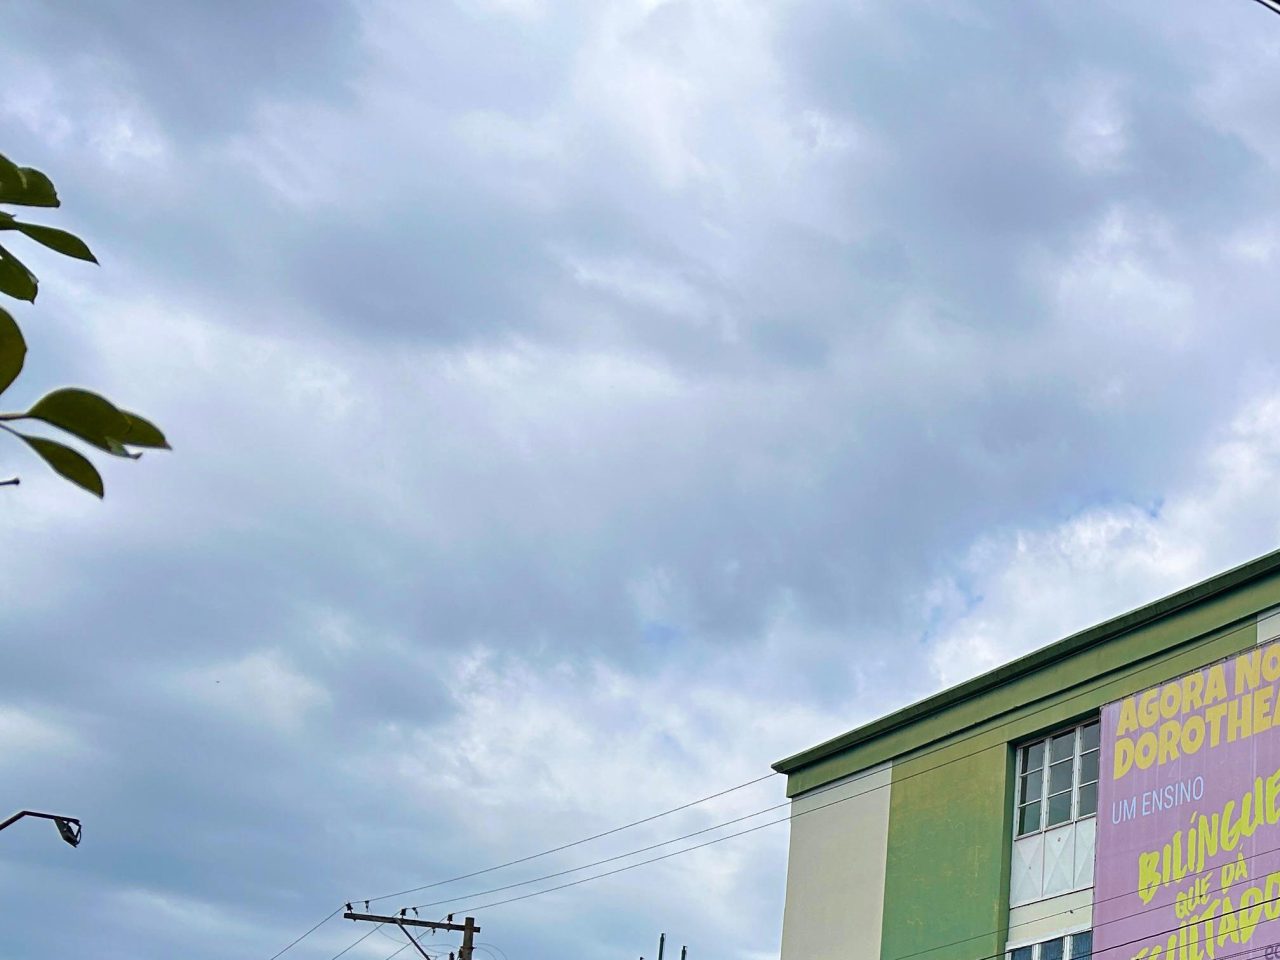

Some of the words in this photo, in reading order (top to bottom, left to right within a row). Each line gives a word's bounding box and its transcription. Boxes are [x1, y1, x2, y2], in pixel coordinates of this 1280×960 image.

[1116, 664, 1227, 736] AGORA
[1112, 796, 1136, 825] UM
[1142, 776, 1204, 816] ENSINO
[1175, 871, 1213, 919] QUE
[1221, 844, 1248, 894] DÁ
